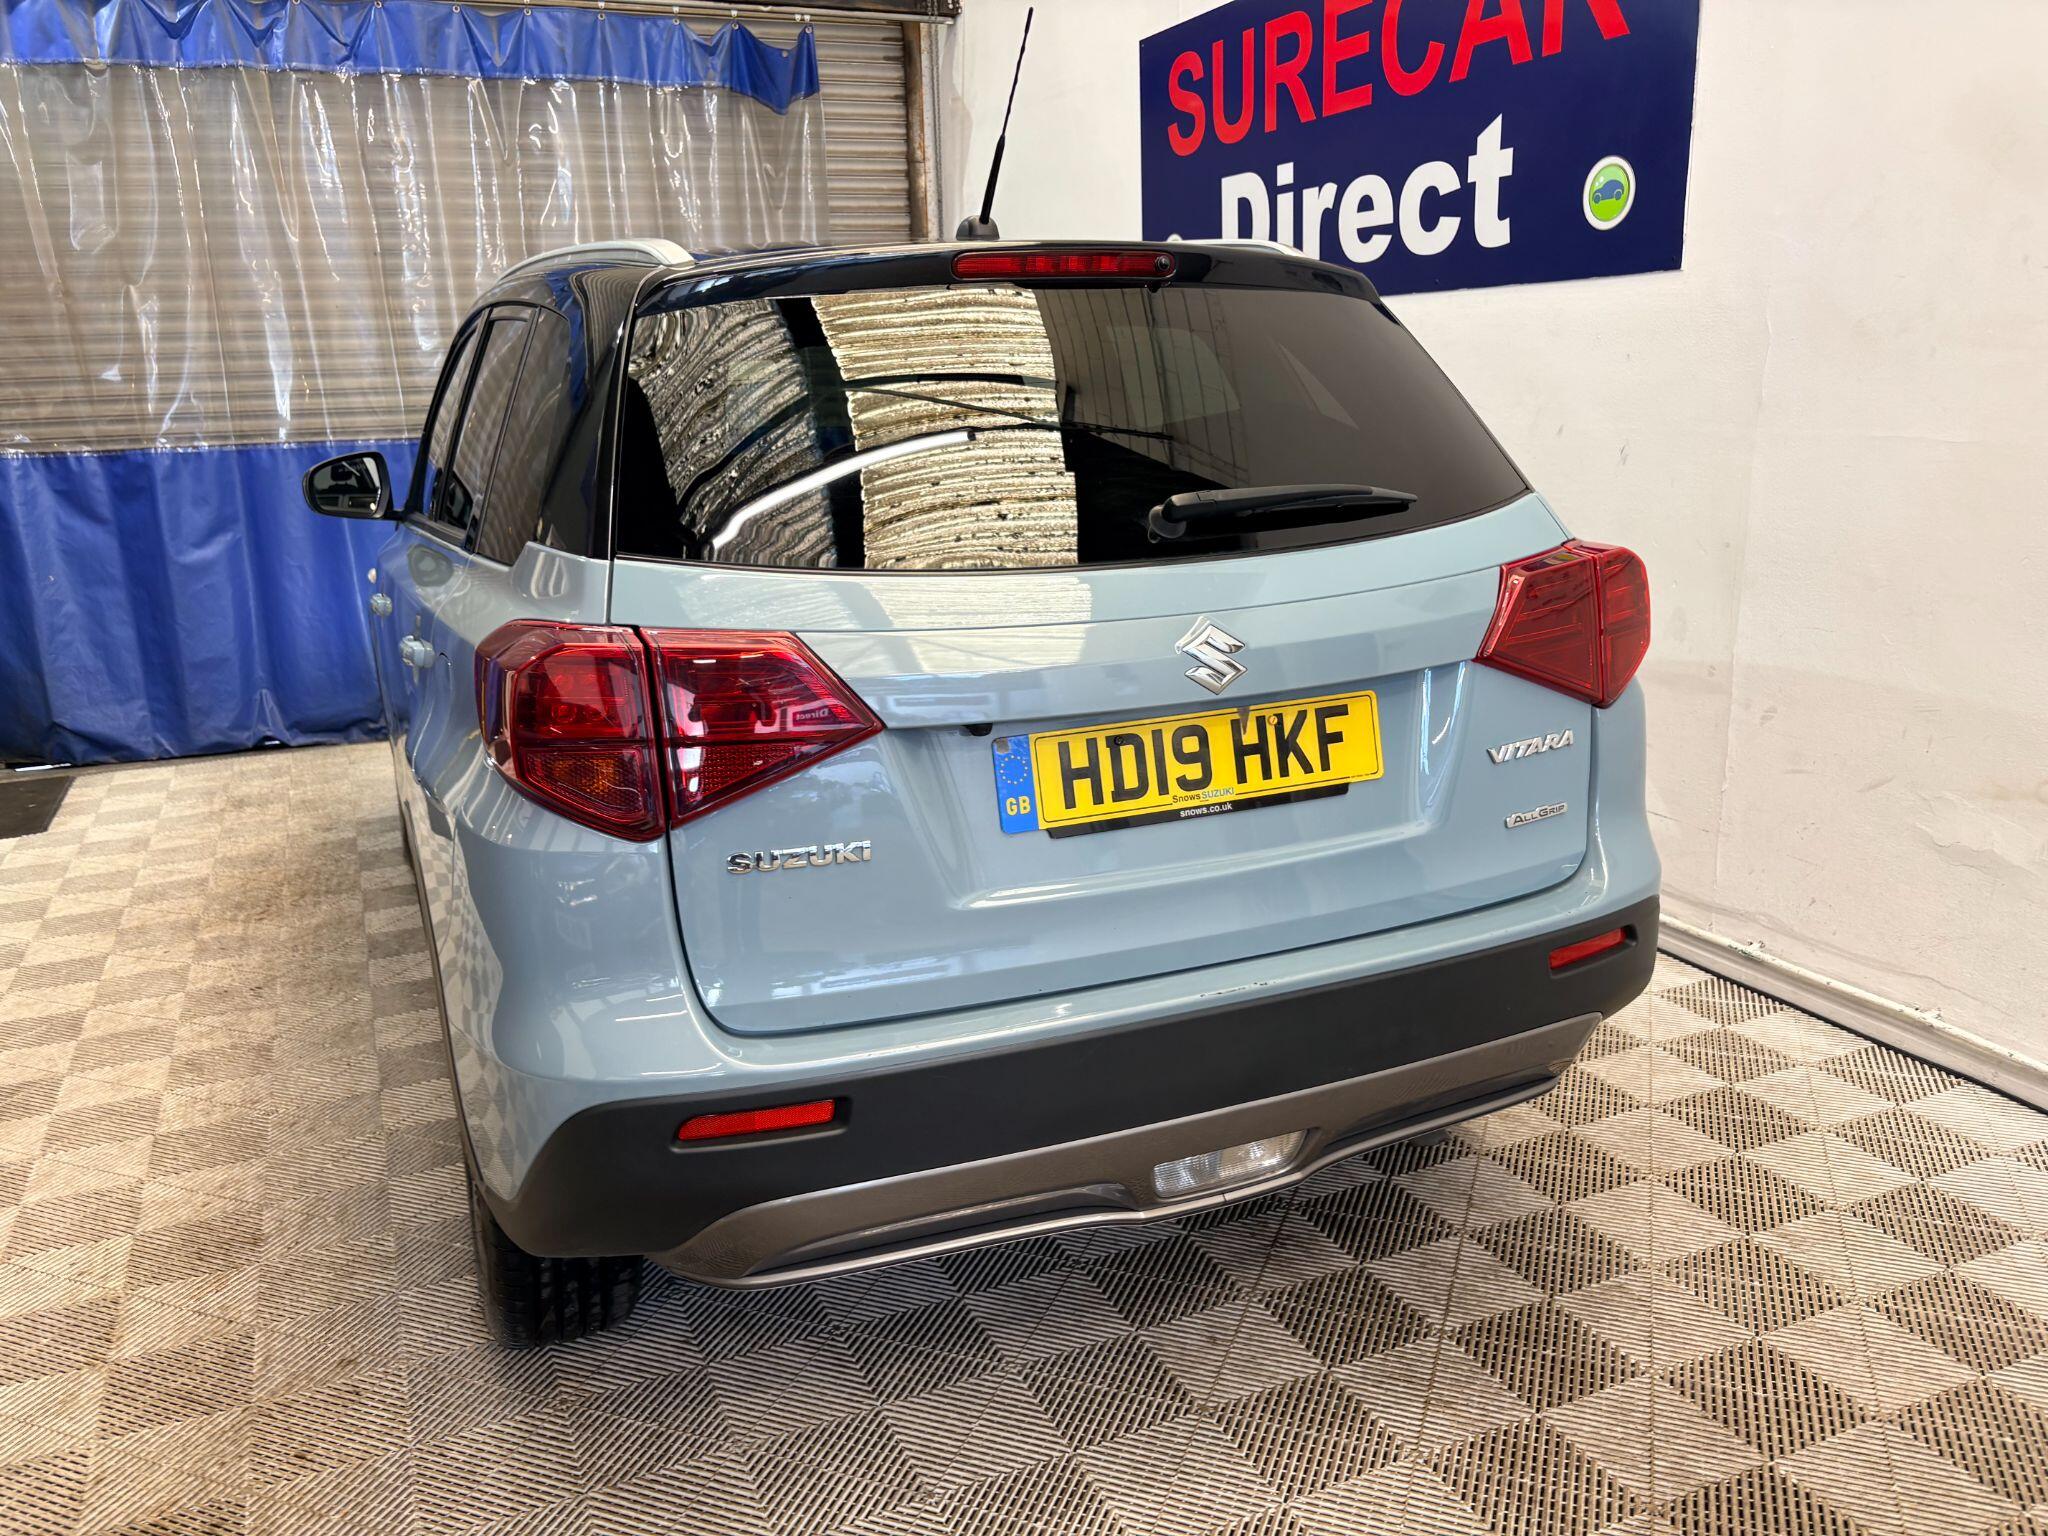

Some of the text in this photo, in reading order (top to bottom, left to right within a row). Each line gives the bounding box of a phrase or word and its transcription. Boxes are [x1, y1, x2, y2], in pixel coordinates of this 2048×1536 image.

[1221, 113, 1513, 263] Direct
[1058, 704, 1349, 810] HD19 HKF
[1487, 729, 1574, 764] VITARA
[1006, 795, 1031, 816] GB
[1180, 802, 1233, 817] snows.co.uk
[727, 840, 871, 874] SUZUKI
